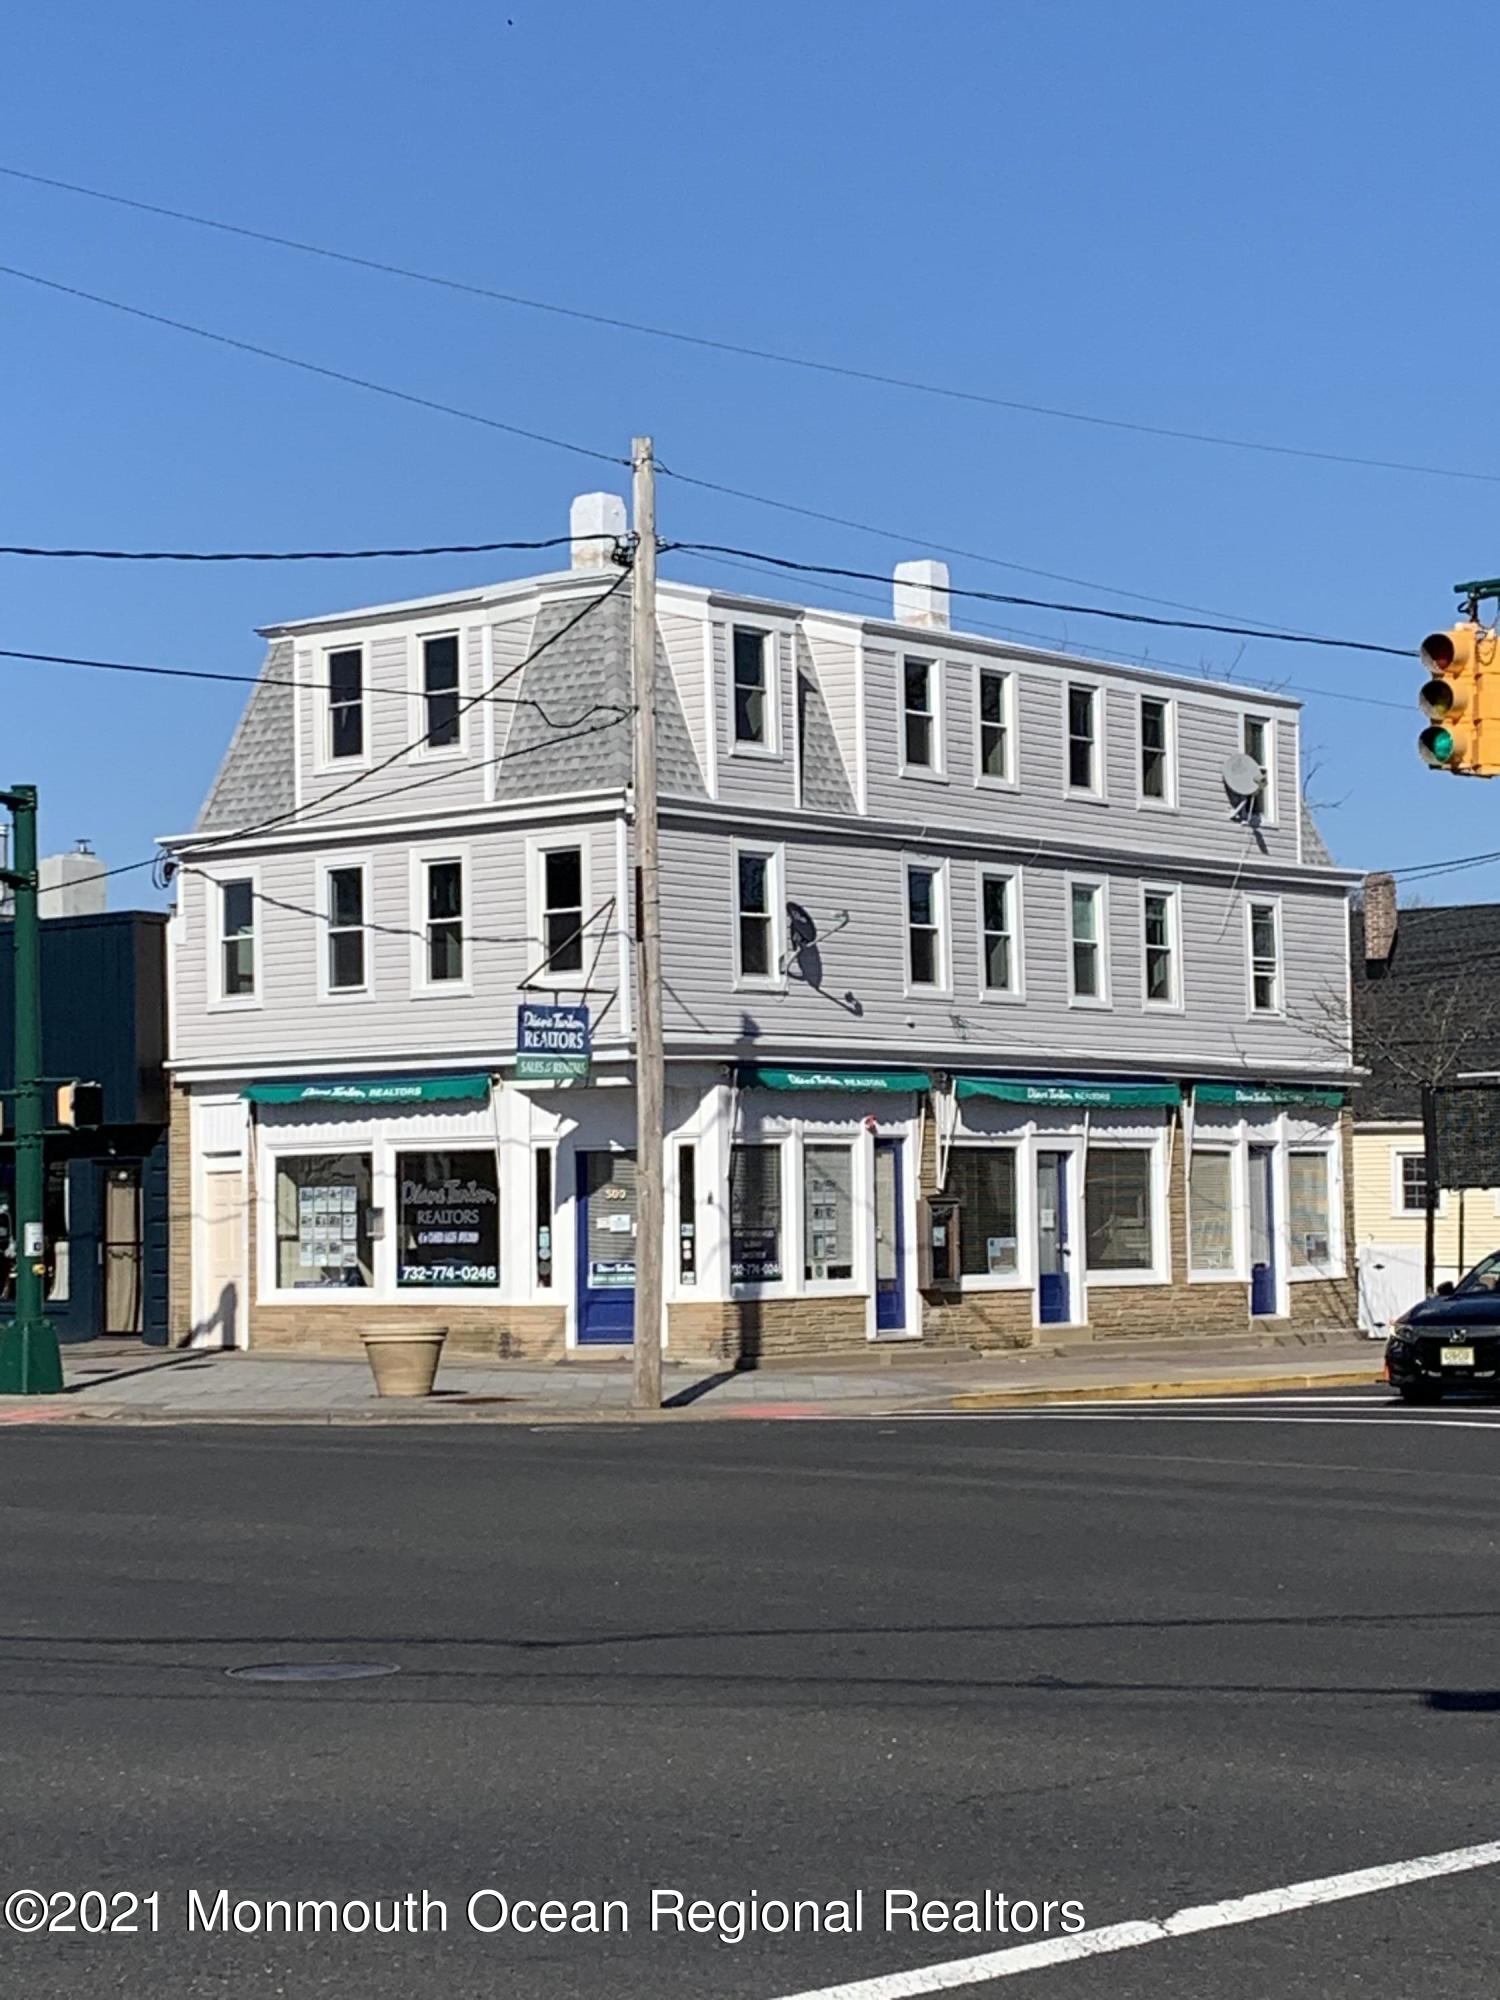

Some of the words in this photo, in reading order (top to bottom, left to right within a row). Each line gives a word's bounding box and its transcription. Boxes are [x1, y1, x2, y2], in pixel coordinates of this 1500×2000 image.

[525, 1031, 584, 1049] REALTORS
[368, 1086, 421, 1097] REALTORS
[417, 1209, 480, 1225] REALTORS
[402, 1265, 497, 1280] 732-774-0246
